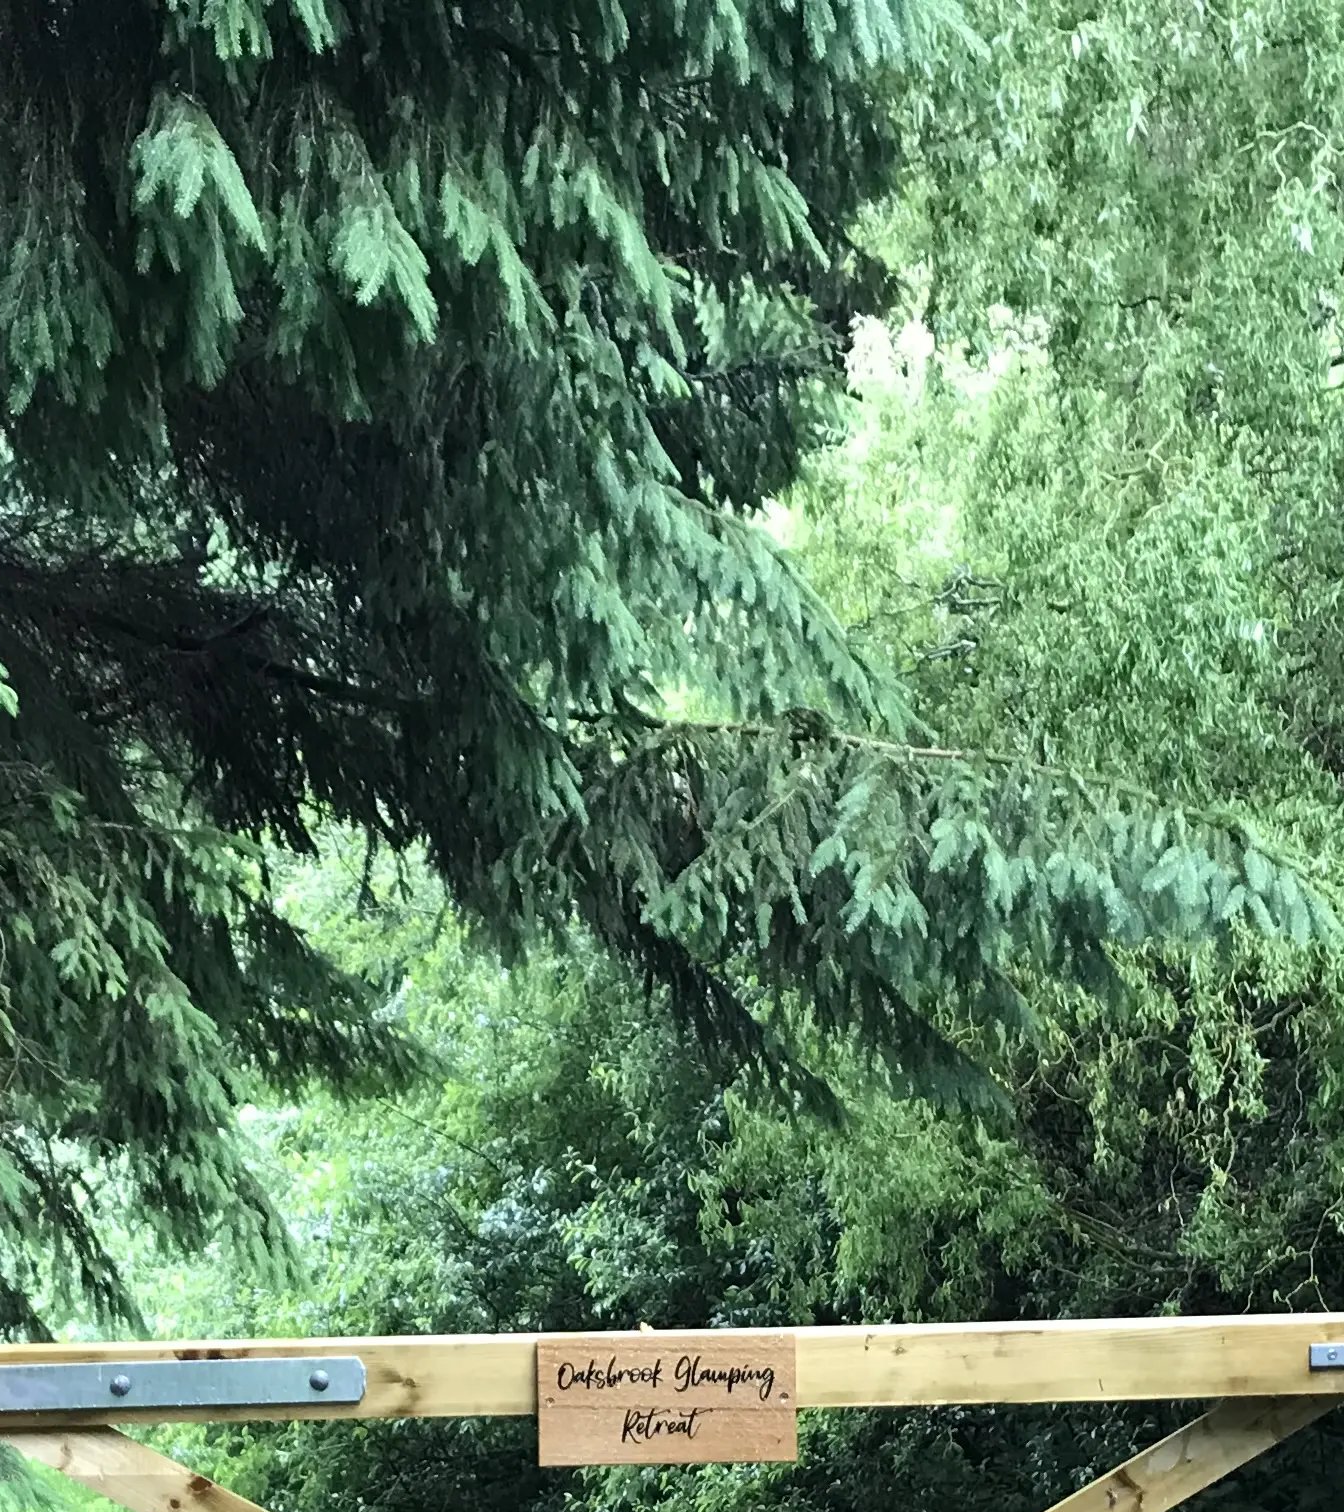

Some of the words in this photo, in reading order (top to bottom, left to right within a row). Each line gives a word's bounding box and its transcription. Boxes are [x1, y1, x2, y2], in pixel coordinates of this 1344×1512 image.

[557, 1356, 663, 1390] Oaksbrook
[674, 1355, 775, 1401] Glamping
[621, 1408, 713, 1444] Retreat
